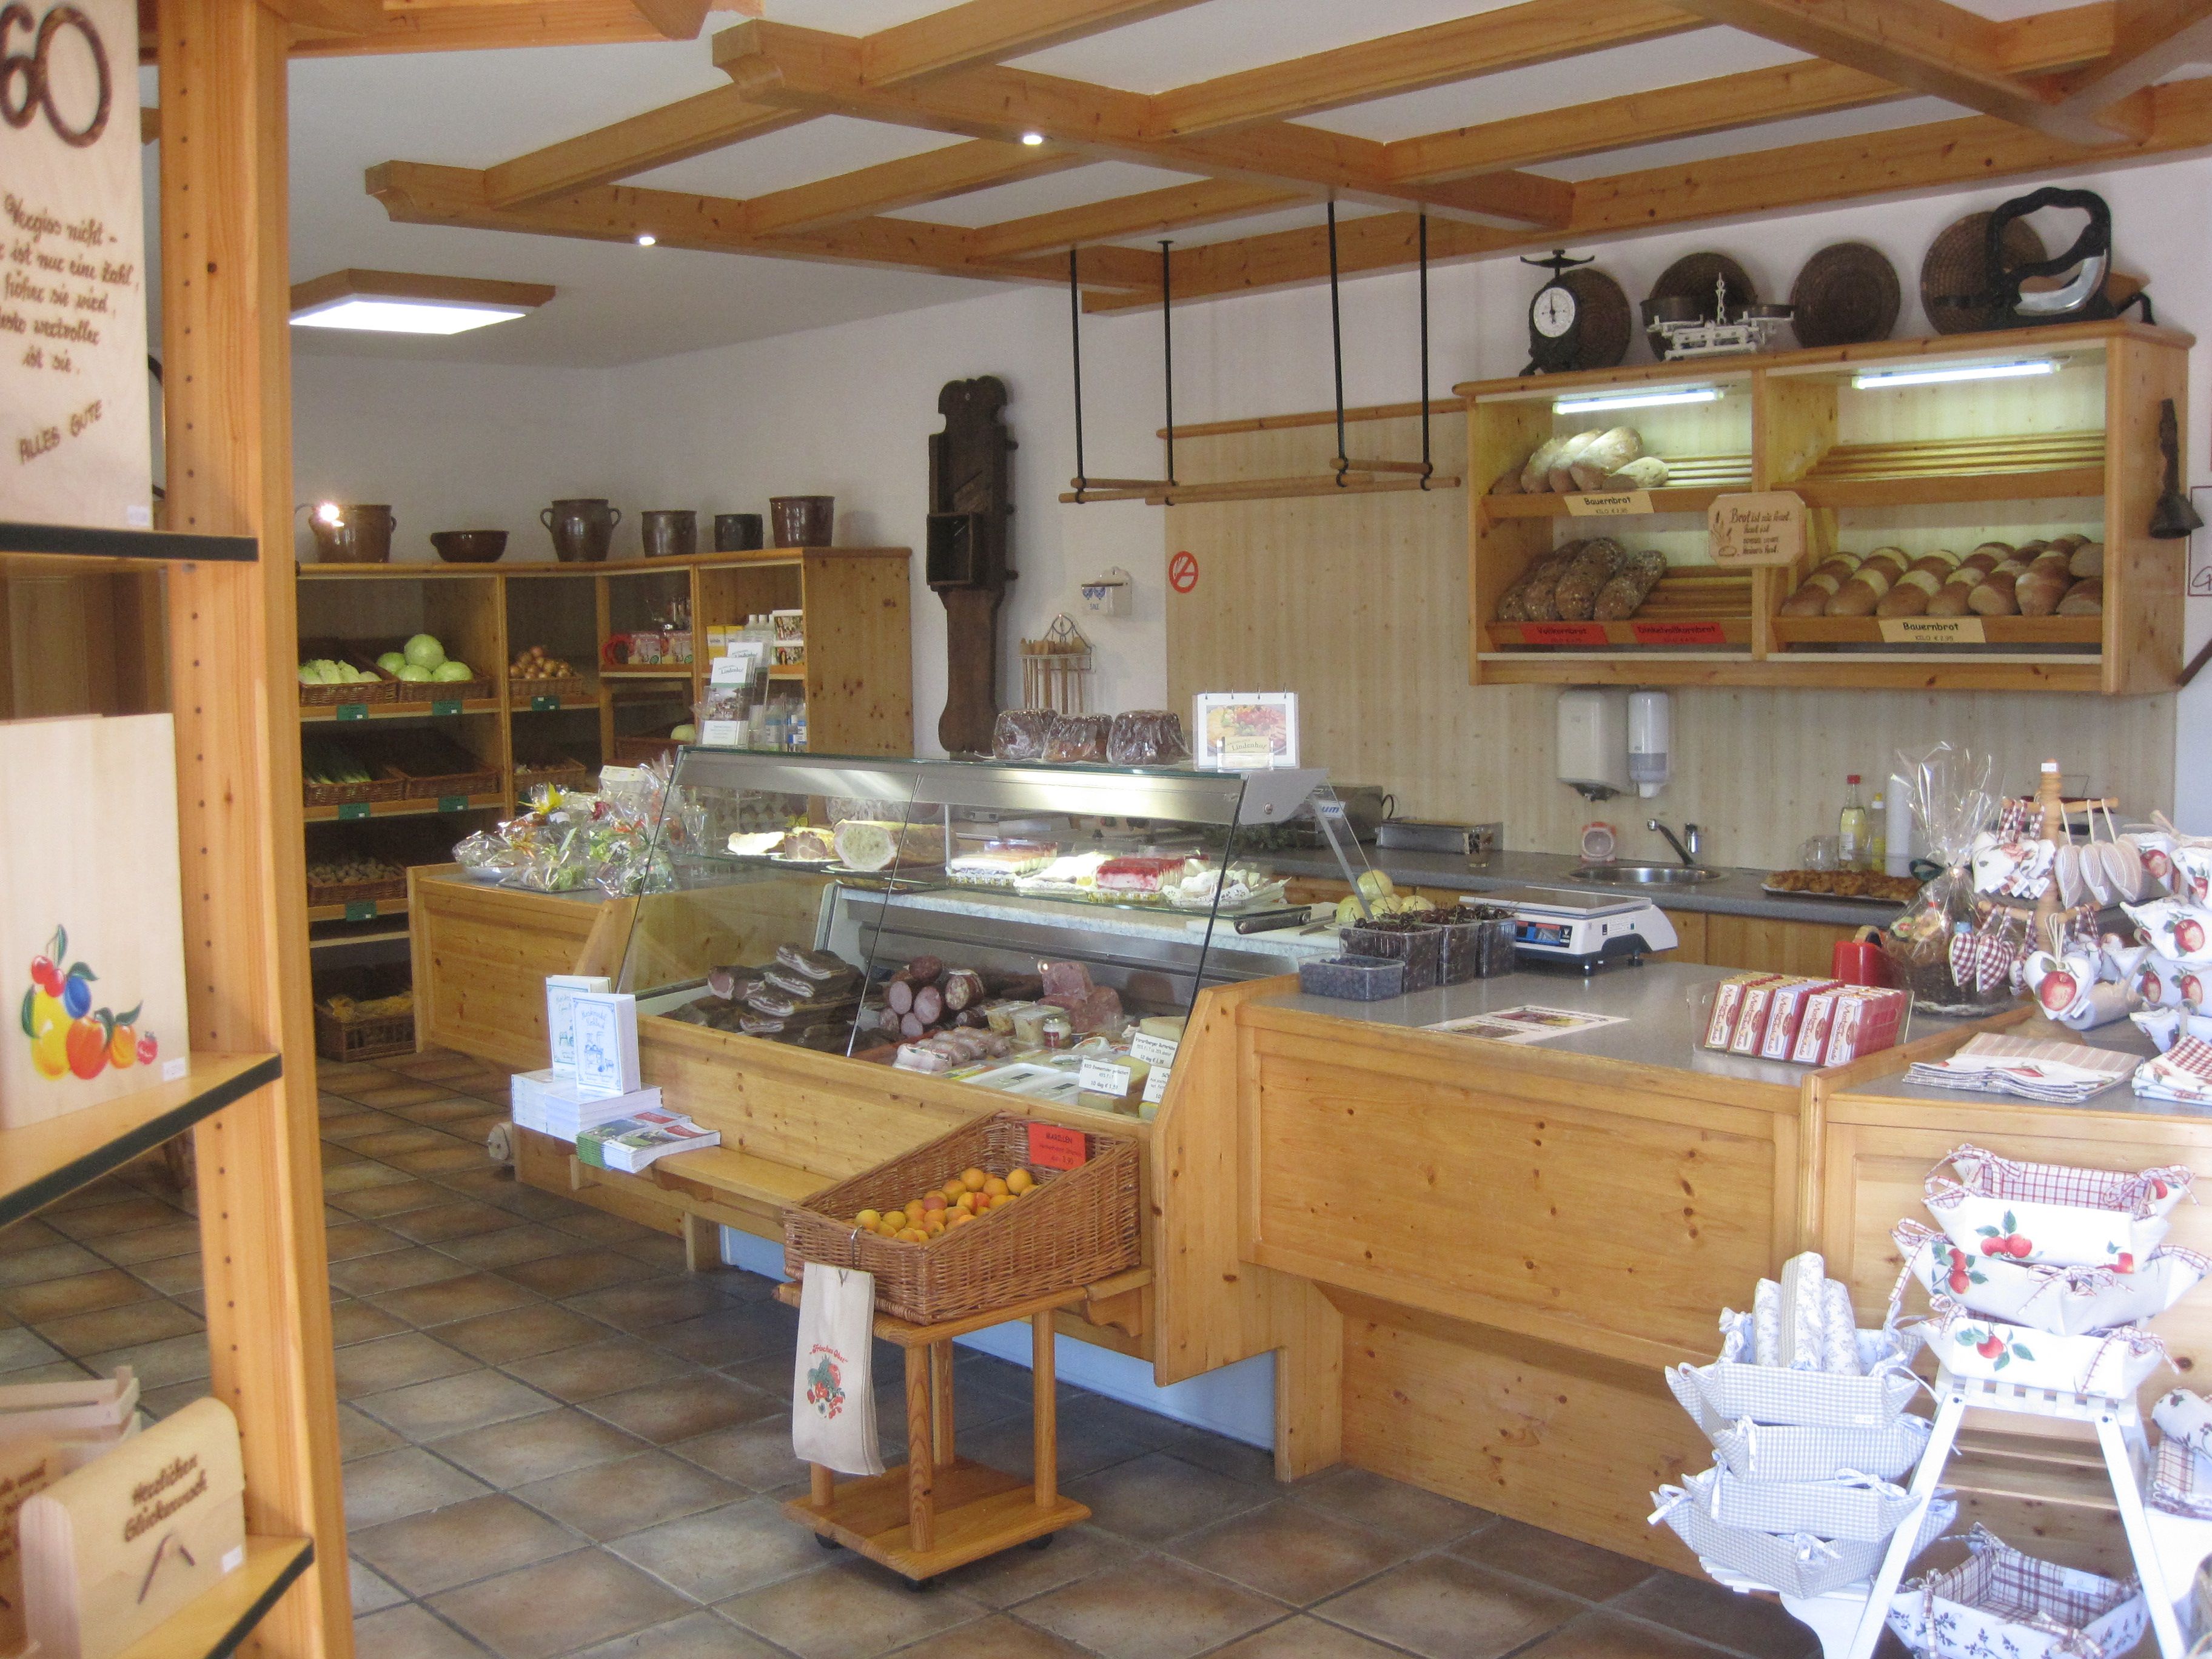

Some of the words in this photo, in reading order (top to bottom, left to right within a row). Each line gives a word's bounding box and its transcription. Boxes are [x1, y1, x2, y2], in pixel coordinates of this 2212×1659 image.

[0, 4, 112, 148] 60
[19, 426, 61, 465] ALLES
[70, 399, 102, 438] GUTE
[1584, 496, 1631, 505] Bauernbrot
[1731, 508, 1751, 523] Brot
[1637, 625, 1715, 634] Dinkelvollkornbrot
[1903, 622, 1959, 631] Bauernbrot
[1232, 741, 1267, 751] Lindenhof
